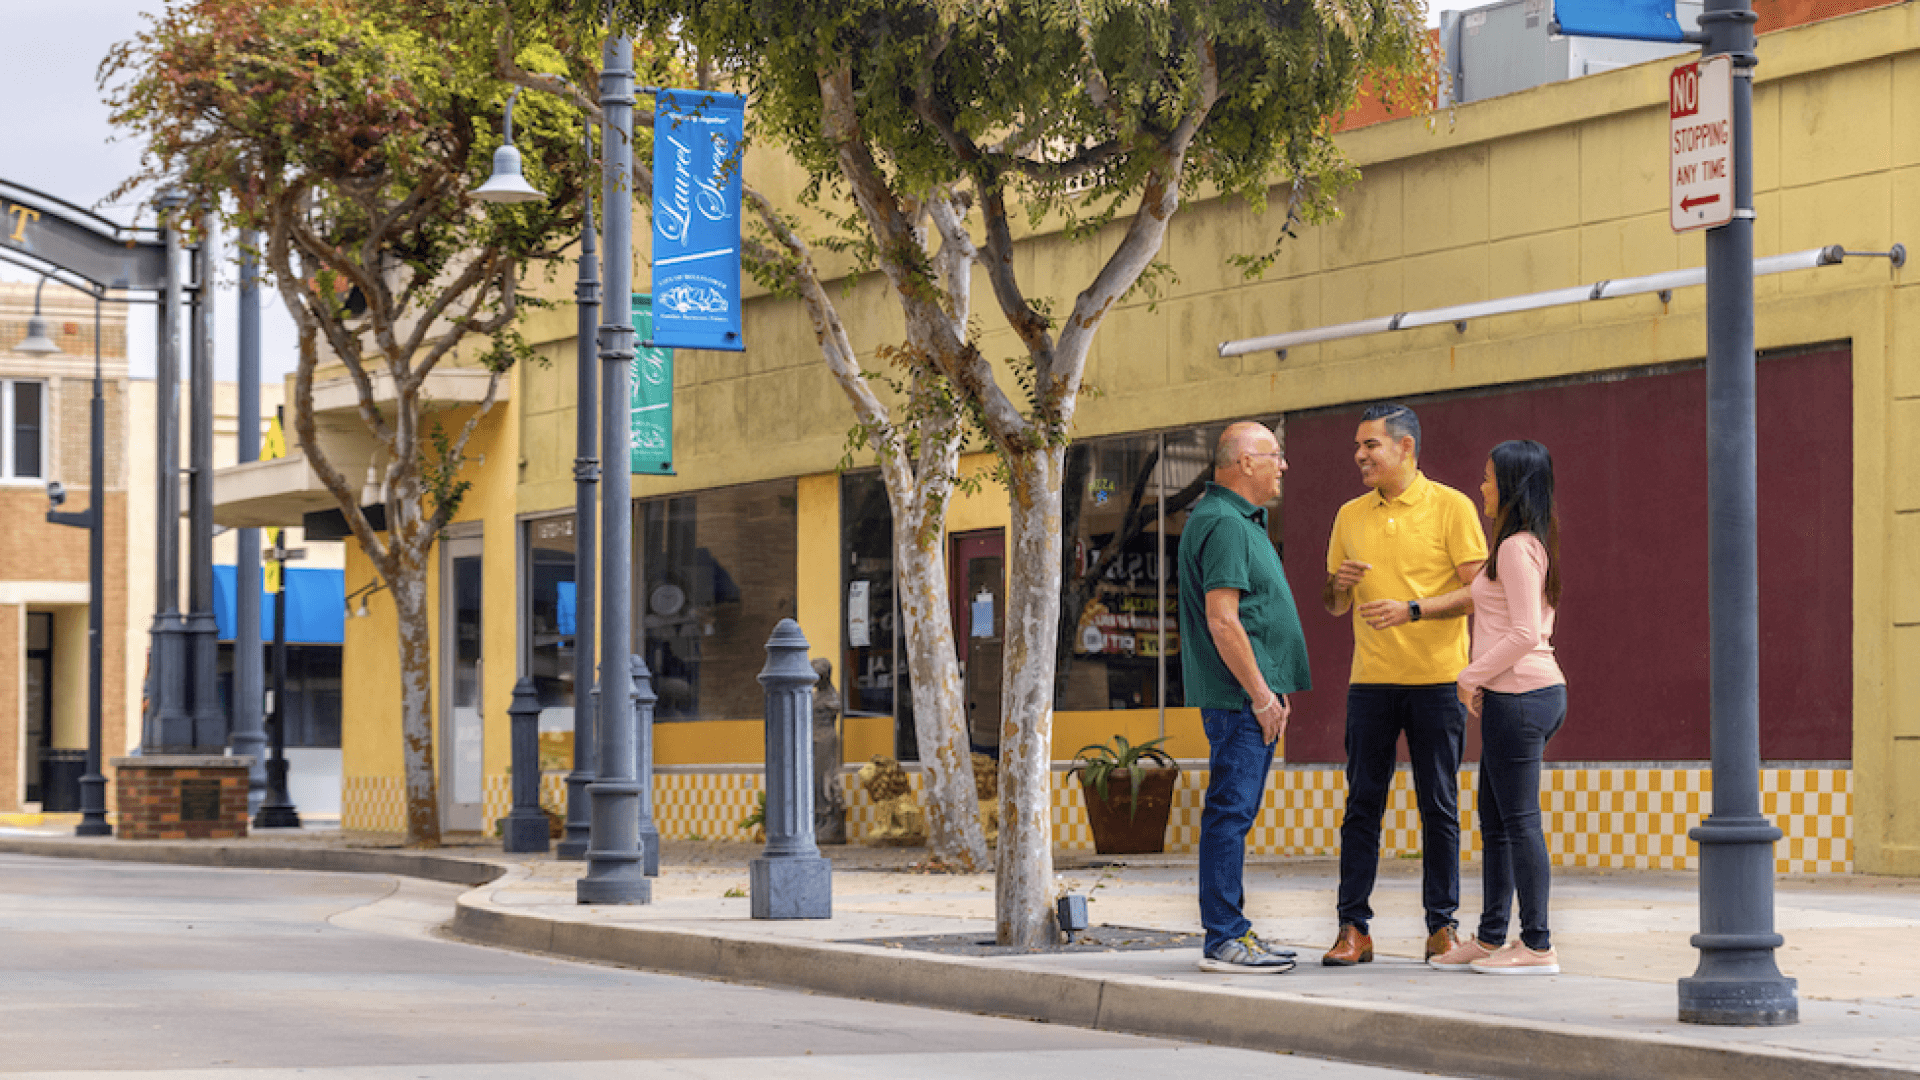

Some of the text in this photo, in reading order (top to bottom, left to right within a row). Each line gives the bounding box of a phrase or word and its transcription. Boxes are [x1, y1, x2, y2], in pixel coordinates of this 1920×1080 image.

[1672, 72, 1696, 112] NO
[1674, 120, 1728, 155] STOPPING
[1676, 157, 1727, 186] ANY TIME
[656, 135, 691, 247] Laurel
